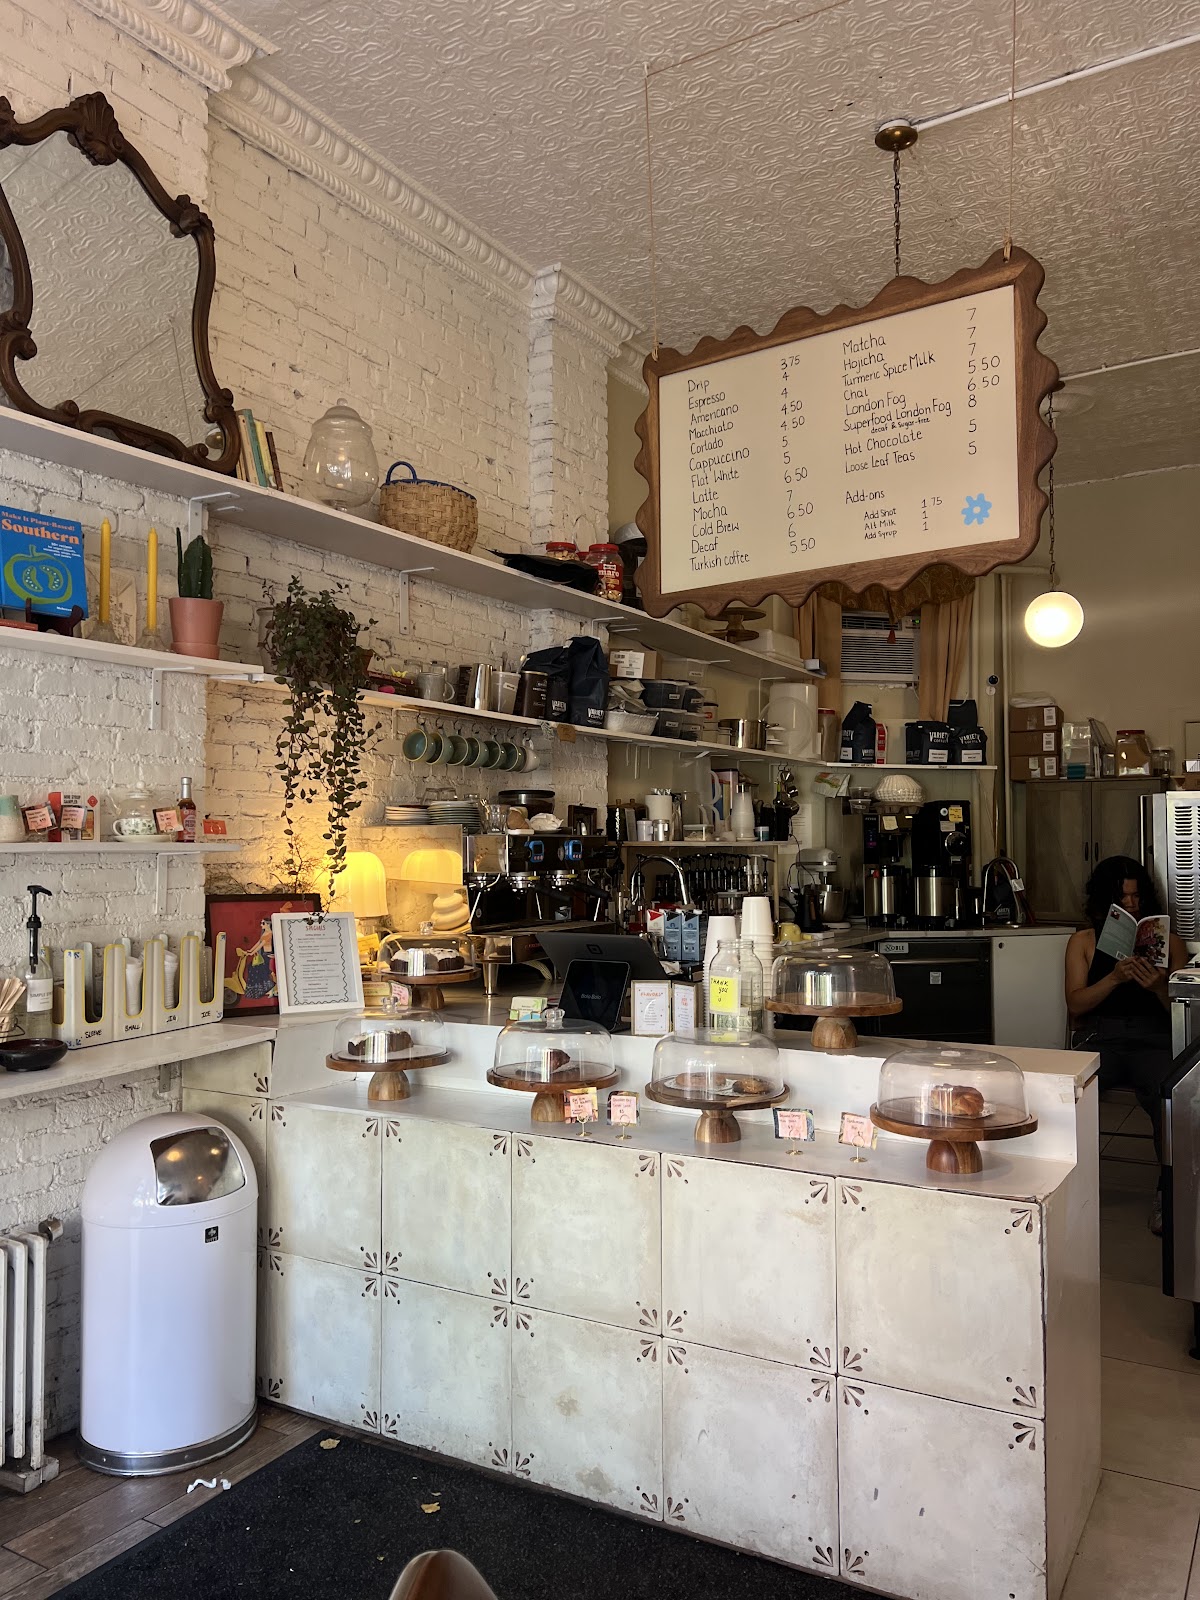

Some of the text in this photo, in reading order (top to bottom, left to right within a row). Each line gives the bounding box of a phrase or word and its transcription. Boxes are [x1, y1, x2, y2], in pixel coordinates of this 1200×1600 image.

[966, 308, 977, 321] 7
[967, 327, 976, 339] 7
[843, 333, 887, 355] Matcha
[968, 342, 976, 356] 7
[842, 351, 936, 387] Turmeric Spice Milk
[844, 352, 885, 374] Hojicha
[968, 355, 1000, 374] 5.50
[782, 372, 790, 381] 4
[968, 375, 1000, 391] 6.50
[688, 380, 710, 394] Drip
[781, 388, 788, 399] 4
[689, 392, 726, 413] Espresso
[844, 389, 869, 401] Chai
[968, 394, 977, 408] 8
[781, 400, 803, 415] 4.50
[846, 391, 907, 416] London Fog
[691, 404, 739, 426] Americano
[843, 398, 952, 434] Superfood London Fog
[689, 421, 734, 440] Macchiato
[781, 416, 805, 431] 4.50
[871, 424, 888, 434] decaf
[968, 419, 977, 433] 5
[691, 438, 724, 455] Cortado
[782, 436, 788, 448] 5
[845, 430, 923, 456] Hot Chocolate
[968, 441, 977, 455] 5
[689, 448, 750, 473] Cappuccino
[784, 451, 791, 465] 5
[846, 451, 916, 474] Loose Leaf Teas
[691, 468, 740, 488] Flat White
[784, 467, 808, 484] 6.50
[693, 488, 719, 504] Latte
[787, 490, 793, 502] 7
[846, 489, 885, 504] Add-ons
[921, 497, 943, 508] 1.75
[693, 503, 728, 522] Mocha
[787, 502, 814, 520] 6.50
[864, 508, 897, 520] Add Shot
[922, 510, 928, 520] 1
[2, 511, 21, 520] Make
[31, 517, 75, 531] Plant-Based!
[865, 519, 896, 531] Alt Milk
[922, 522, 929, 531] 1
[1, 519, 80, 544] Southern
[693, 520, 740, 538] Cold Brew
[788, 523, 797, 538] 6
[878, 530, 898, 539] Syrup
[692, 536, 718, 554] Decaf
[689, 550, 750, 571] Turkish coffee
[929, 732, 950, 743] VARIETY
[959, 733, 981, 744] VARIETY
[885, 944, 905, 952] NOBLE
[711, 978, 728, 986] THANK
